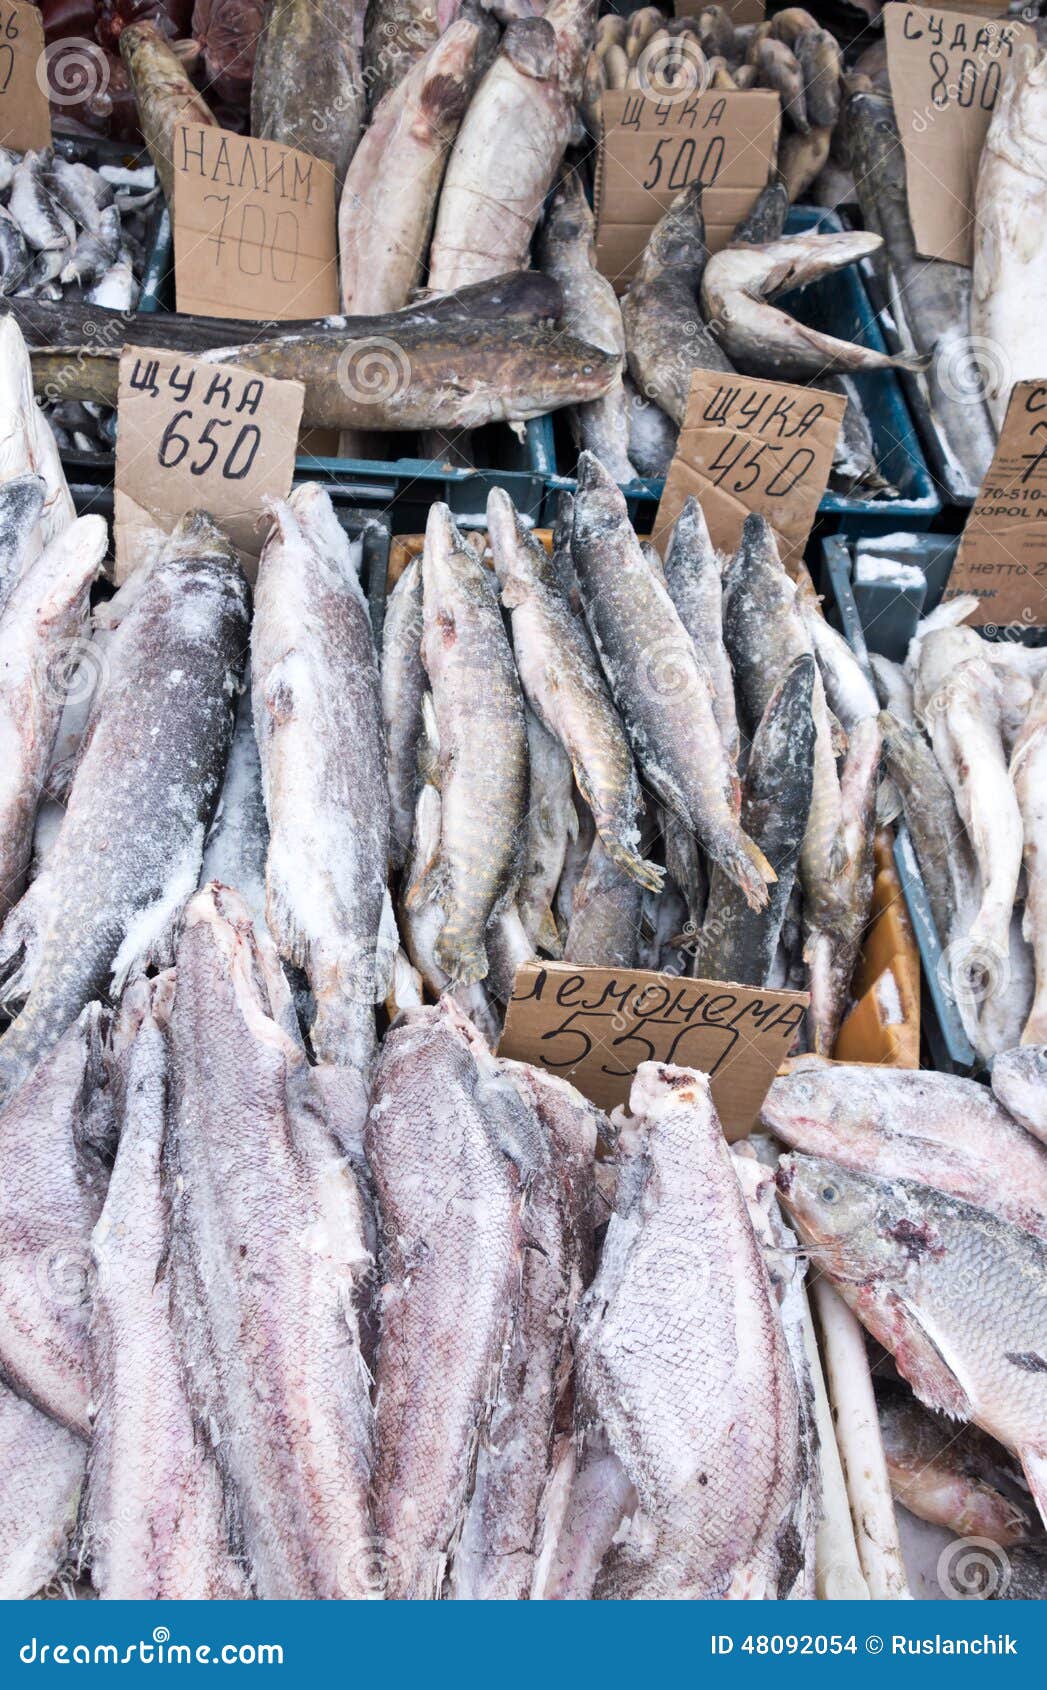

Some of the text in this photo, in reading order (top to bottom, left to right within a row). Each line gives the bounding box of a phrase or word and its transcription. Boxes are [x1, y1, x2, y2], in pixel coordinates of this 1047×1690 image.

[904, 11, 1013, 57] СУДАК
[930, 51, 1001, 111] 800
[621, 95, 728, 132] ЩУКА
[181, 127, 313, 205] НАЛИМ
[643, 136, 726, 190] 500
[204, 195, 299, 283] 700
[130, 359, 264, 415] ЩУКА
[703, 386, 825, 438] ЩУКА
[158, 410, 261, 480] 650
[708, 434, 815, 496] 450
